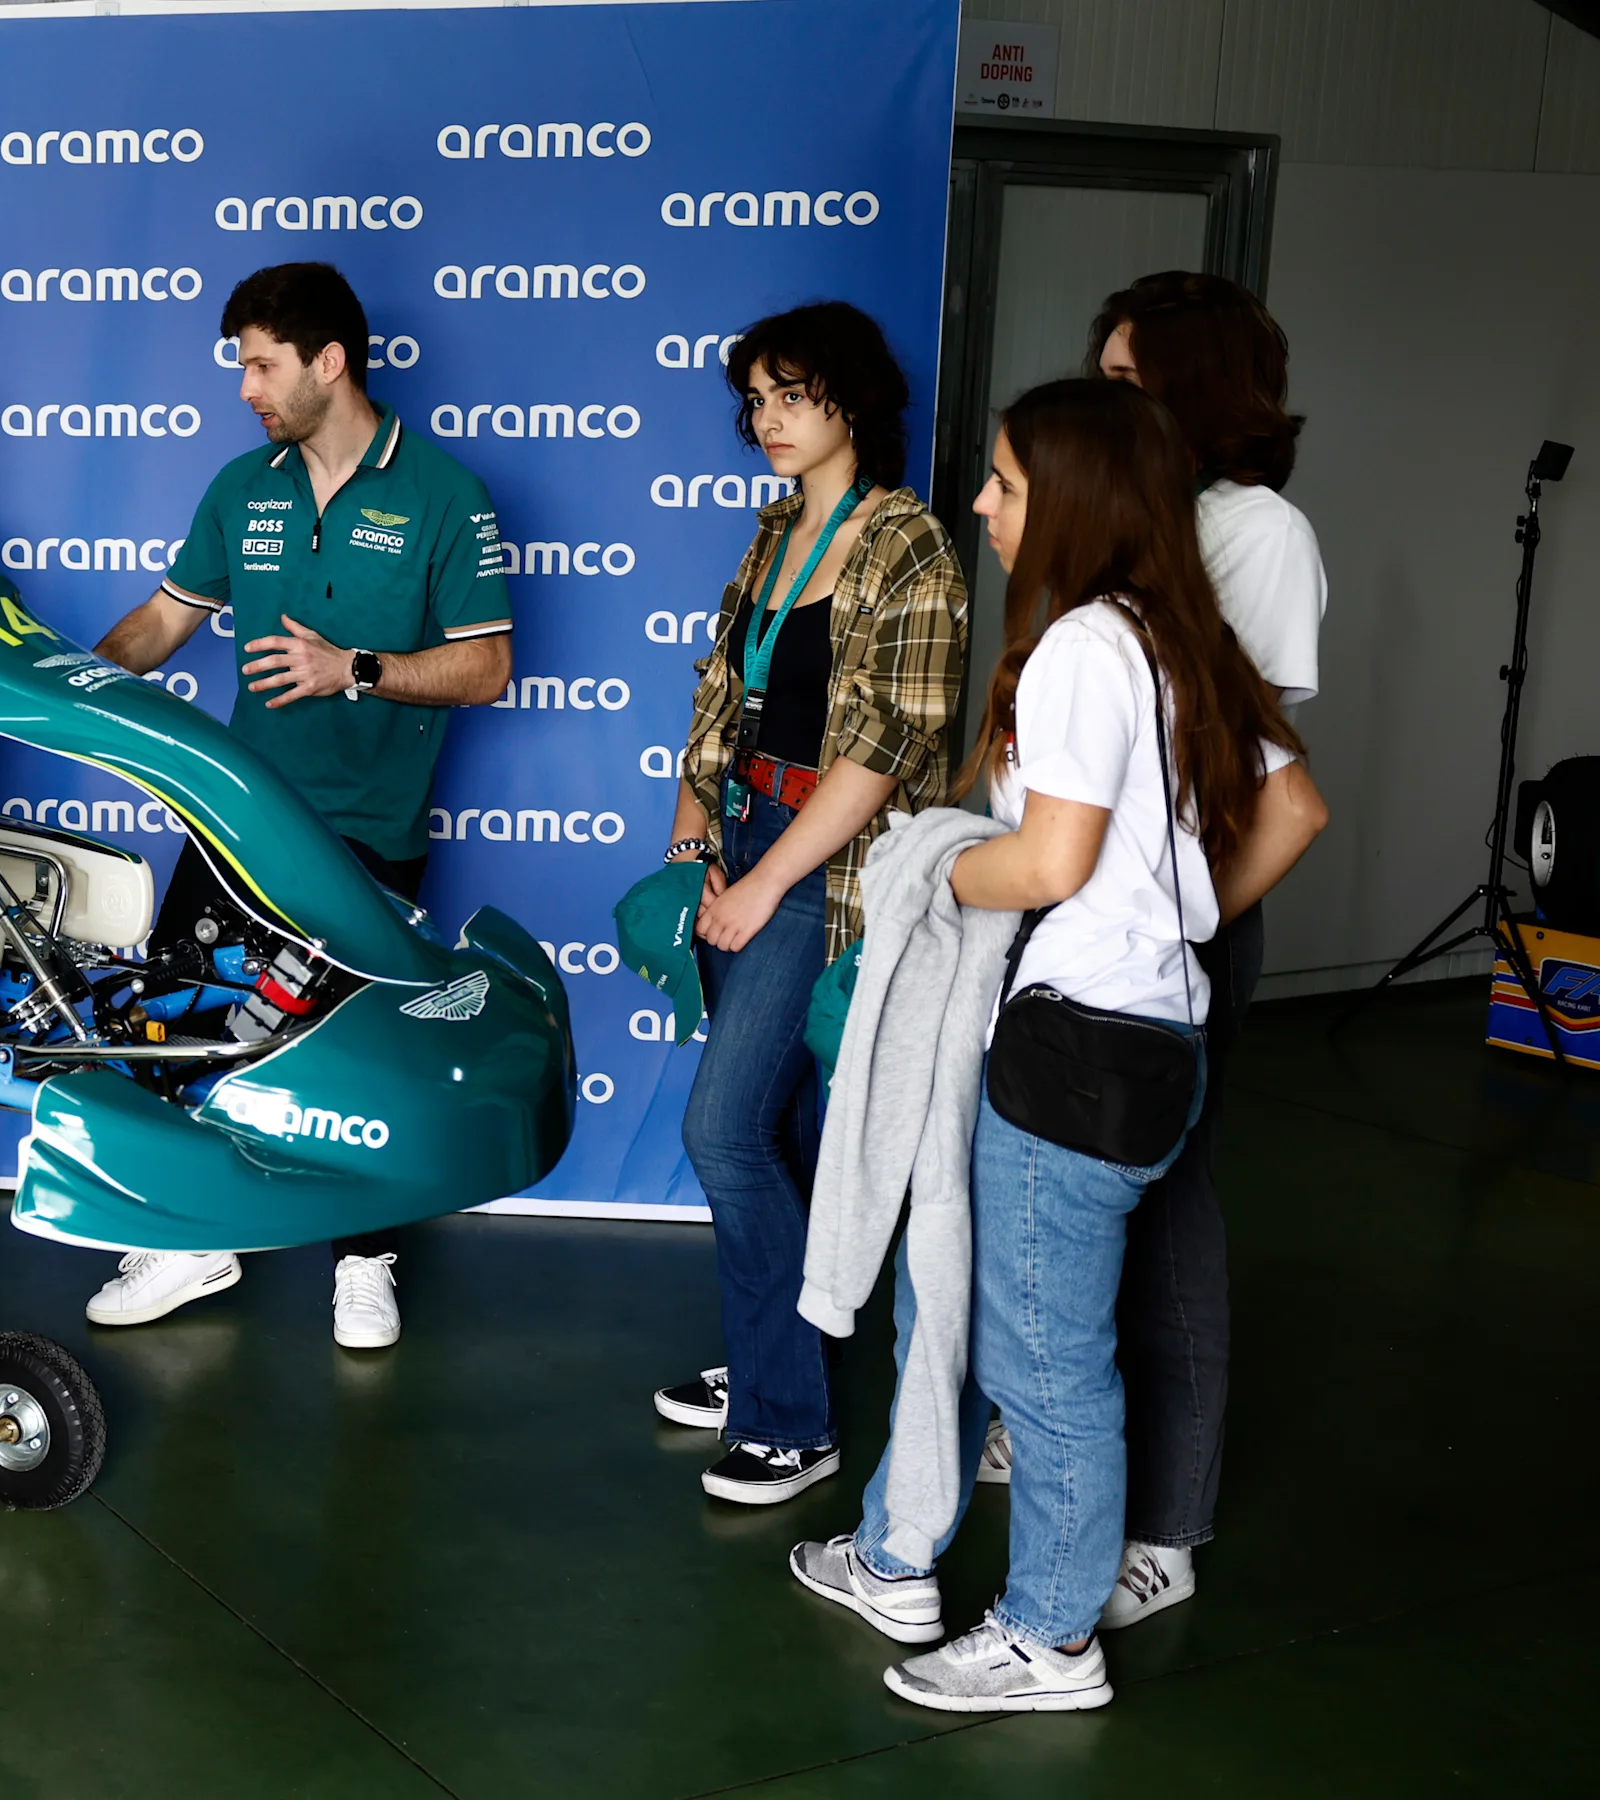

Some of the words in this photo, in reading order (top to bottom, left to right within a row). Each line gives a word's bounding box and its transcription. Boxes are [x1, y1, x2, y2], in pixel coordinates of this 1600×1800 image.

[992, 44, 1024, 62] ANTI
[980, 63, 1033, 82] DOPING
[1, 129, 203, 165] aramco
[438, 123, 651, 159] aramco
[216, 195, 423, 231] aramco
[662, 191, 880, 227] aramco
[1, 267, 203, 302] aramco
[433, 264, 646, 299] aramco
[214, 335, 421, 369] aco
[1, 403, 202, 438] aramco
[430, 404, 641, 439] aramco
[247, 499, 293, 513] cognizant
[650, 473, 798, 508] aram
[247, 519, 284, 533] BOSS
[351, 528, 405, 547] aramco
[814, 497, 855, 552] MARTIN
[244, 541, 281, 553] JCB
[349, 539, 374, 550] FORMULA
[387, 547, 403, 555] TEAM
[501, 541, 636, 576] amco
[243, 562, 281, 572] SentinelOne
[777, 573, 806, 618] ASTON
[755, 621, 780, 679] MARTIN
[455, 676, 631, 711] amco
[1556, 1000, 1577, 1010] RACING
[1576, 1003, 1591, 1013] KART
